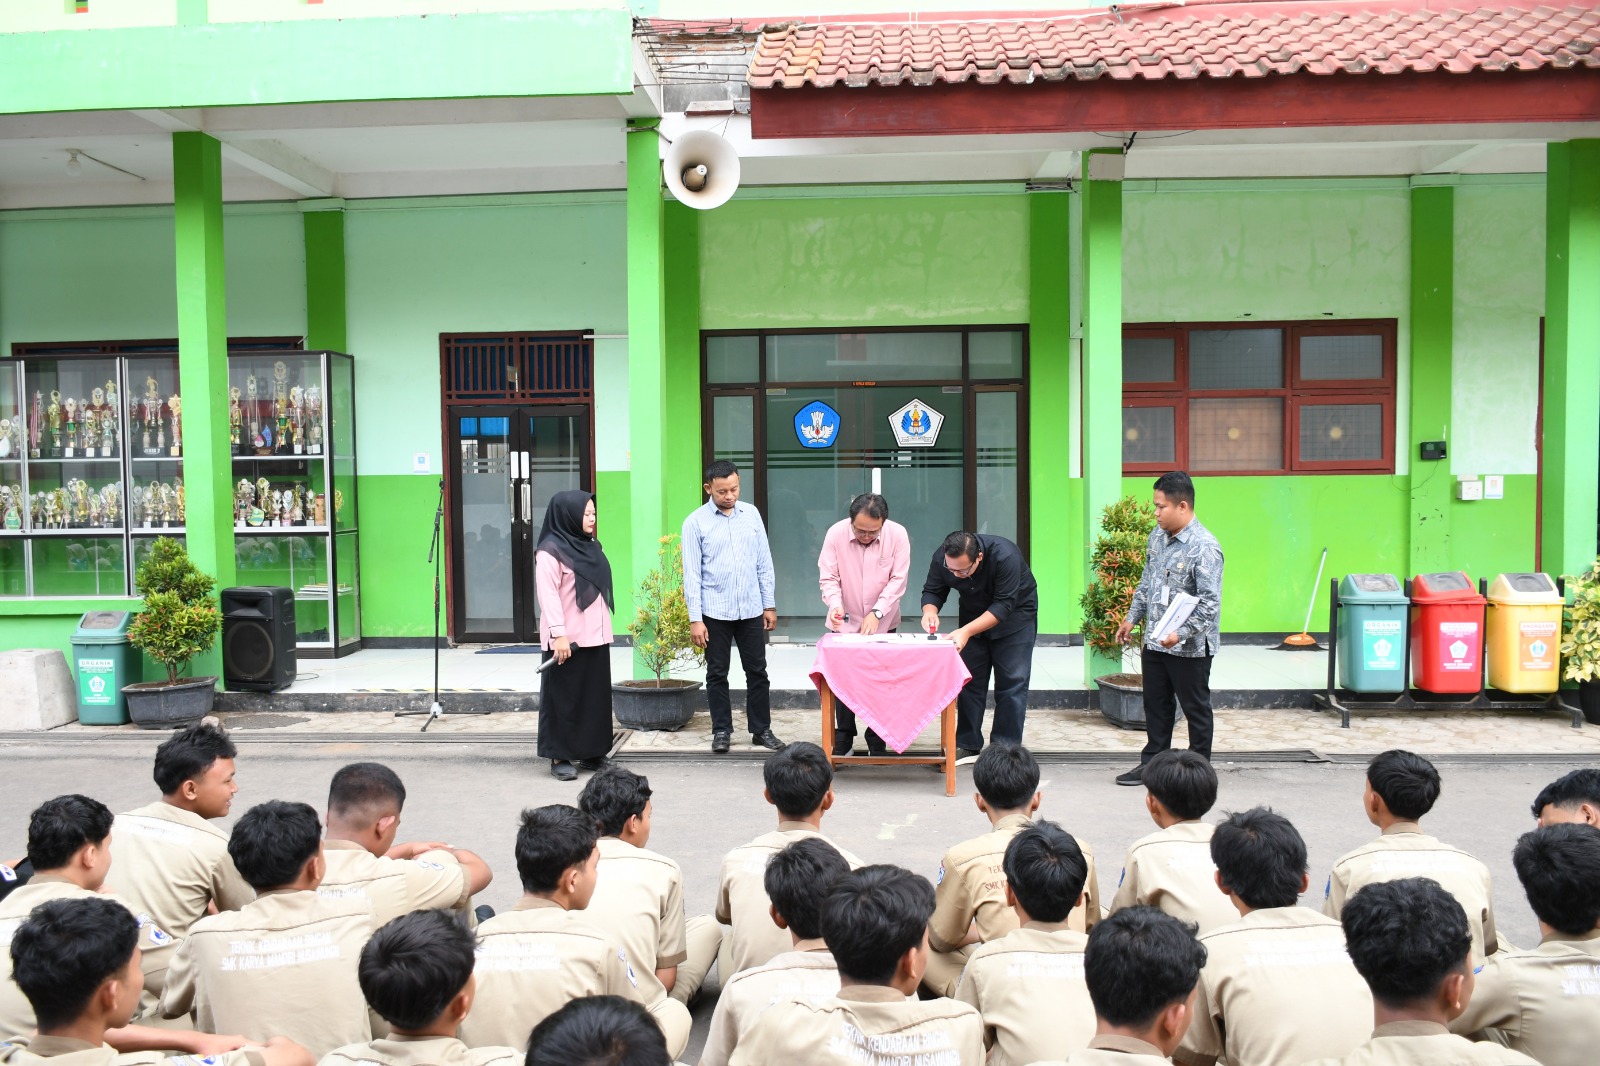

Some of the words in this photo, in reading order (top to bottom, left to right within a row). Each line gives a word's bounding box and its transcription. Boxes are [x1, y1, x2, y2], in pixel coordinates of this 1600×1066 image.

[230, 940, 255, 954] TEKNIK
[222, 957, 237, 970] SMK
[239, 956, 265, 970] KARYA
[867, 1033, 919, 1053] KENDARAAN
